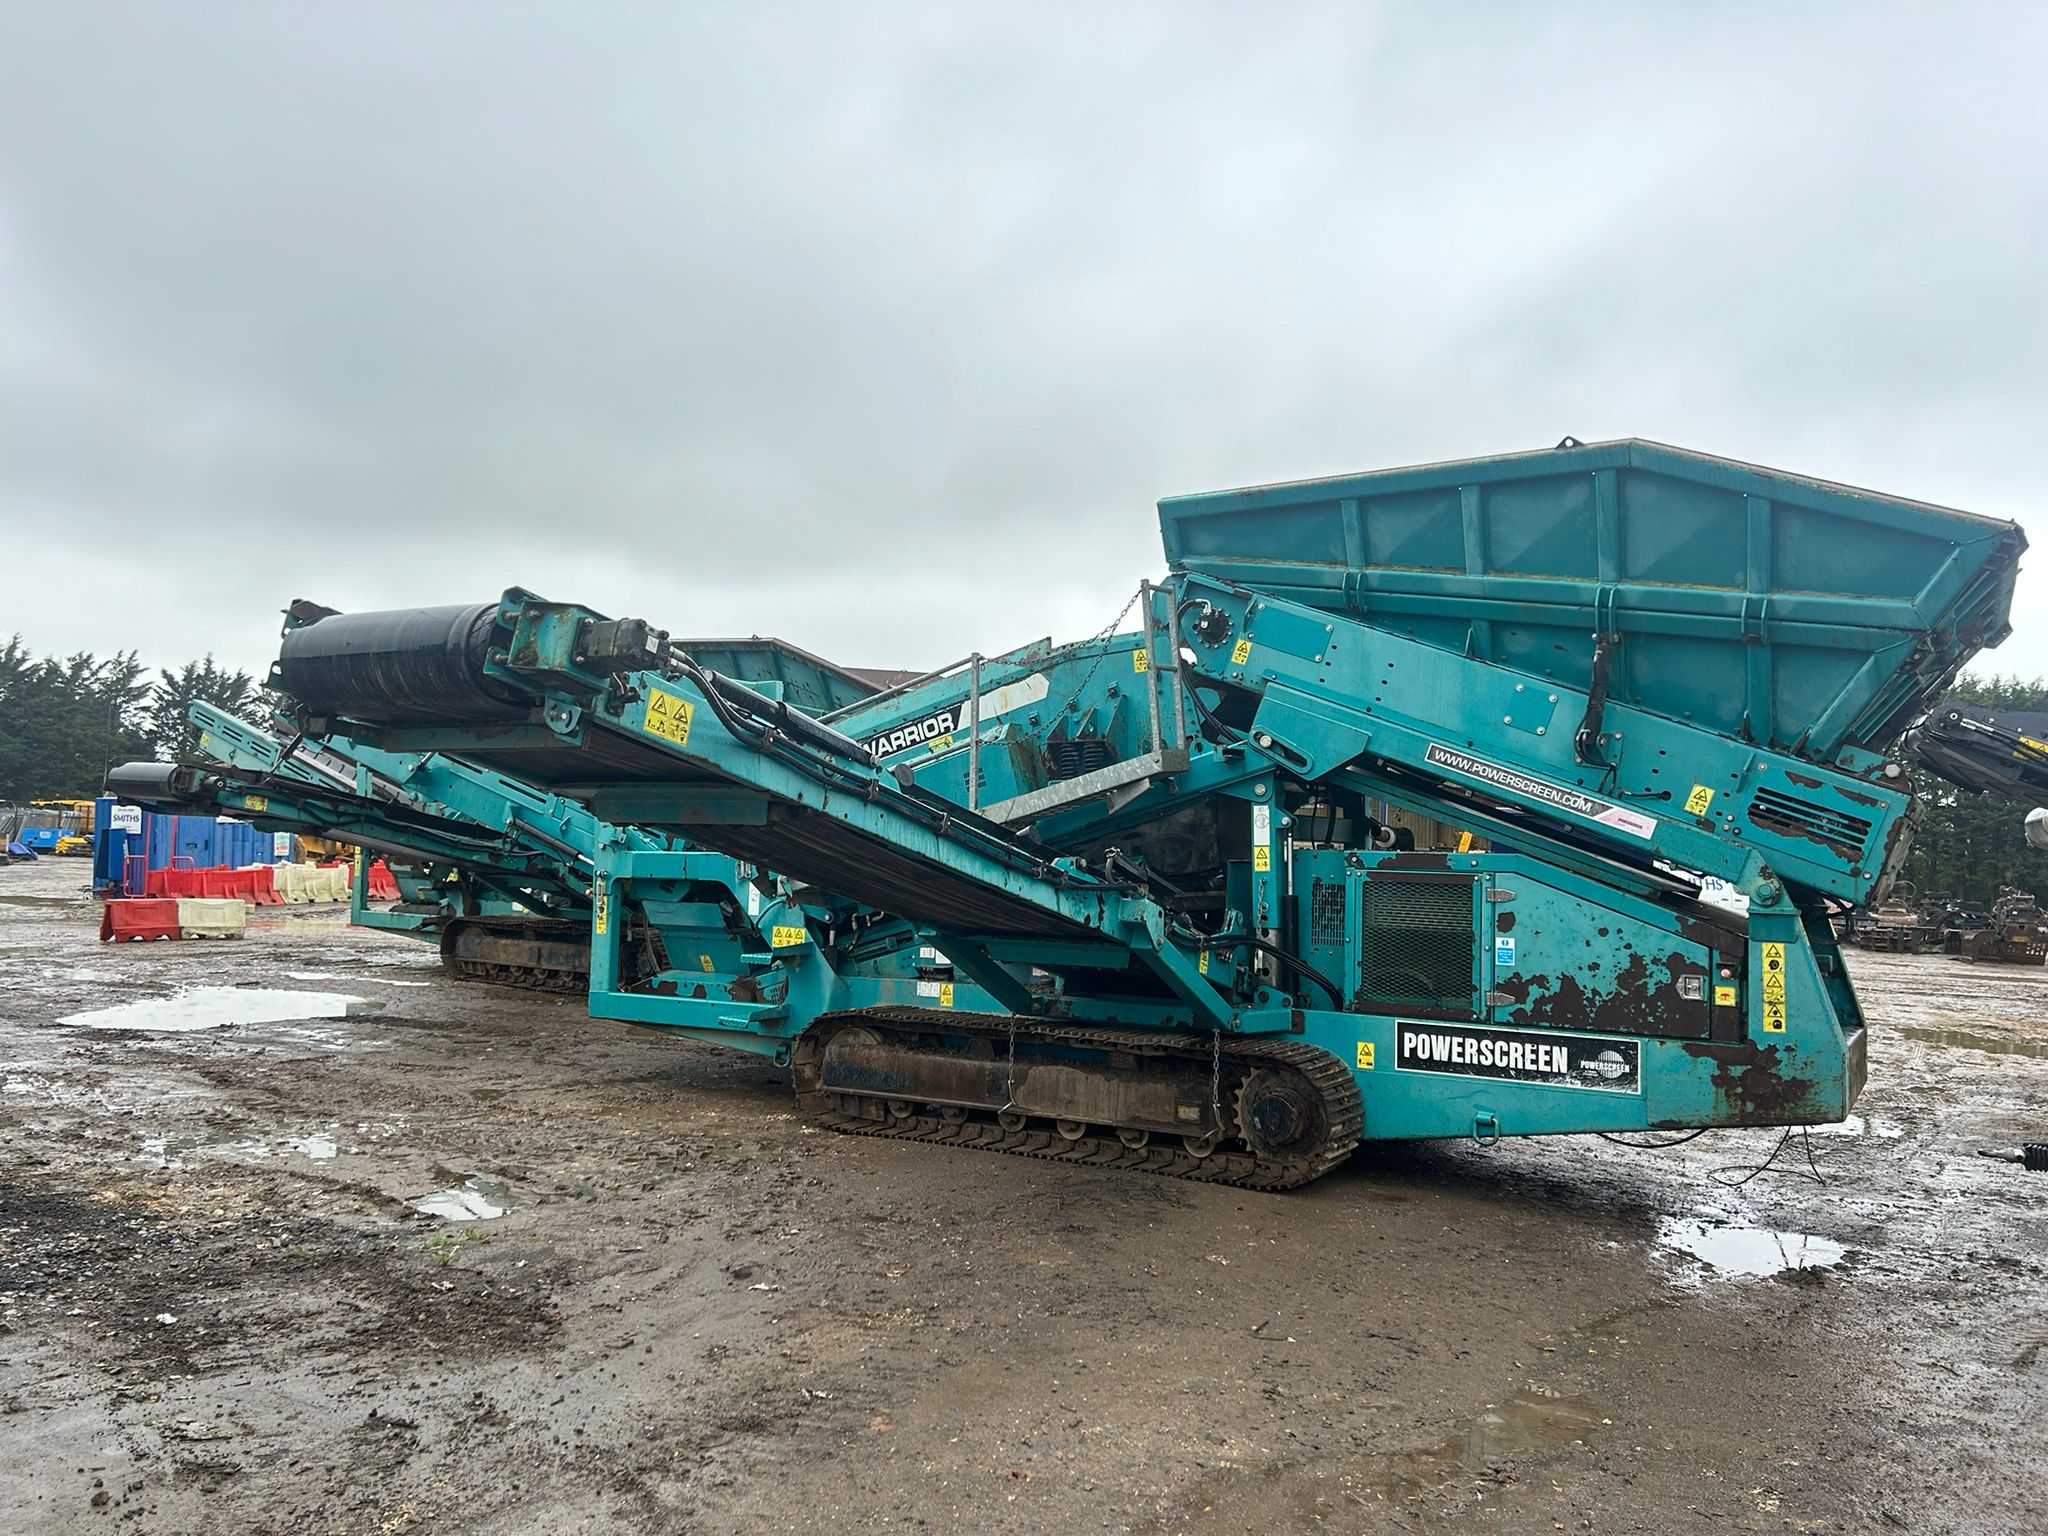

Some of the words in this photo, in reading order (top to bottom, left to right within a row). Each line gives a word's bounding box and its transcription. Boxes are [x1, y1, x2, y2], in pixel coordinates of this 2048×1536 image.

[1435, 749, 1592, 812] WWW.POWERSCREEN.COM
[113, 814, 140, 823] SMITHS
[1403, 1032, 1568, 1074] POWERSCREEN
